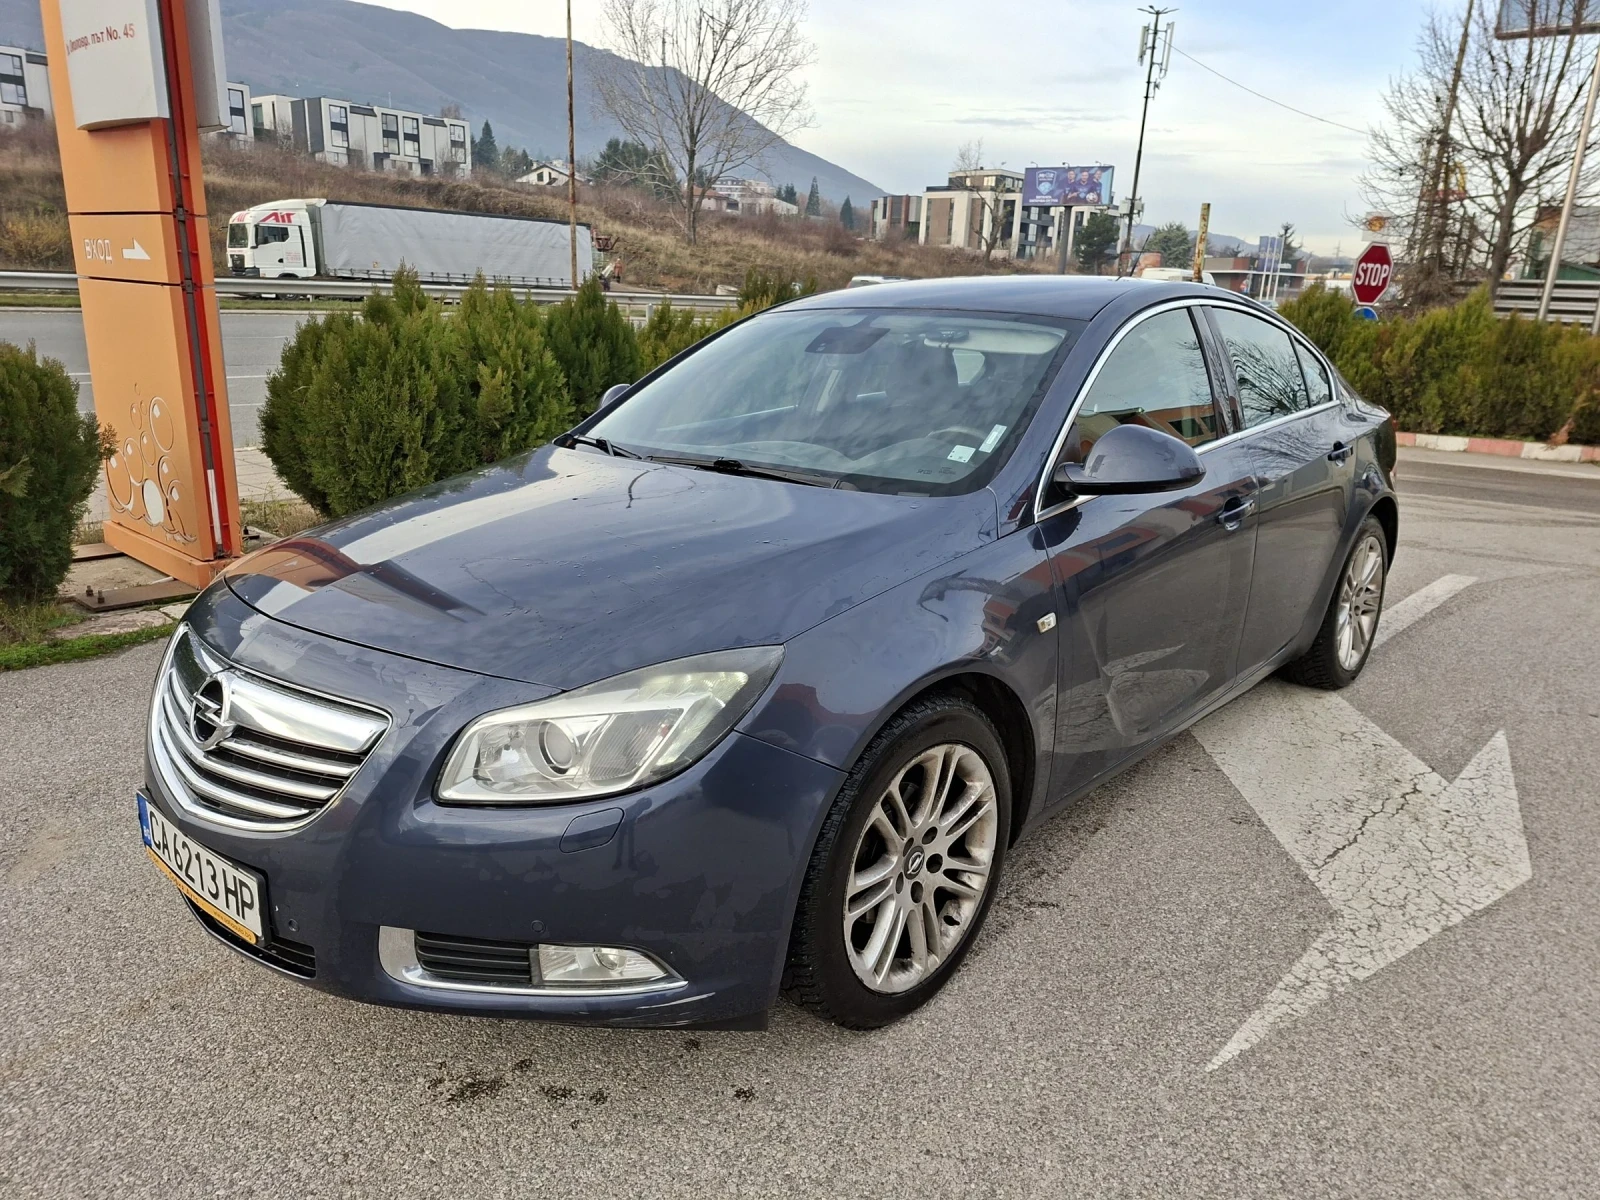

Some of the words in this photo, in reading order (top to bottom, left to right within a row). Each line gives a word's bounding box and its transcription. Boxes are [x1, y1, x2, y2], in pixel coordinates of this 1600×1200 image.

[90, 31, 104, 44] път
[105, 25, 121, 41] No.
[123, 23, 135, 38] 45
[84, 239, 113, 263] ВХОД
[1356, 262, 1390, 287] STOP
